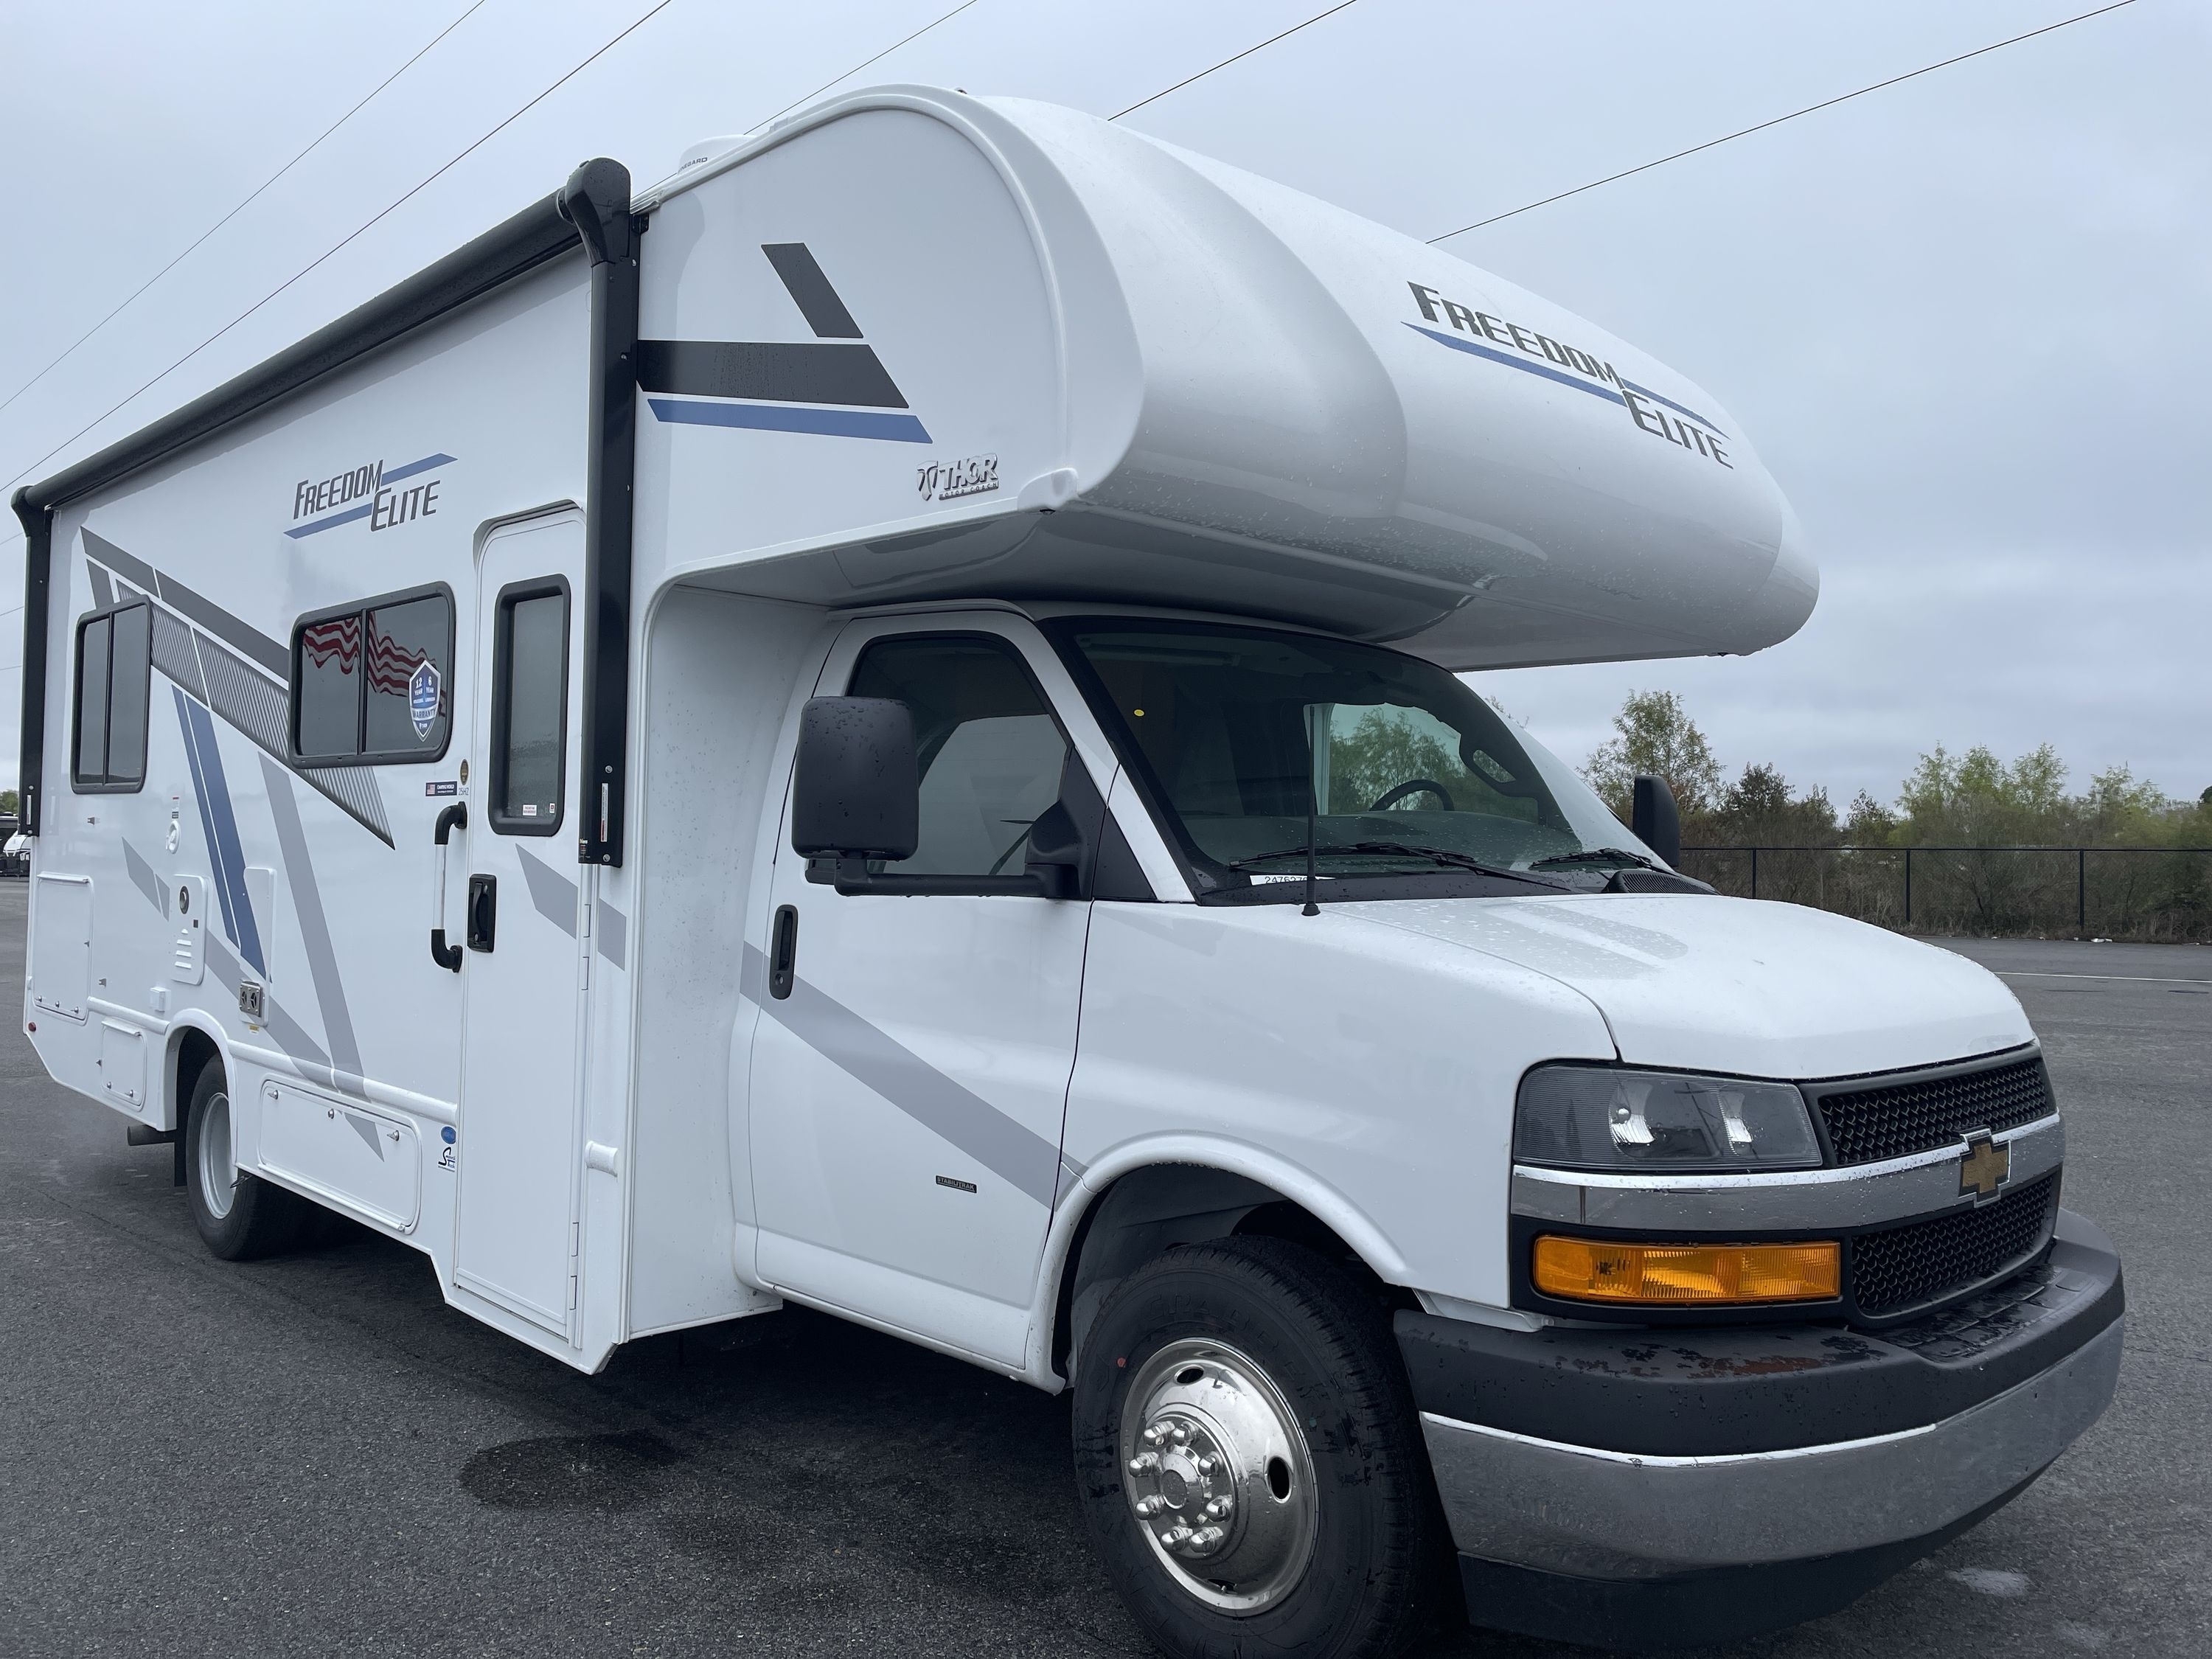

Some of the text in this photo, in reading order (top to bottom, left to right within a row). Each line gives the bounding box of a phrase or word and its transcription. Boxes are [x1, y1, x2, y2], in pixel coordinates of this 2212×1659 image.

[678, 157, 708, 173] INEGARD
[1407, 280, 1625, 389] FREEDOM
[1621, 389, 1734, 470] ELITE
[939, 453, 998, 490] THOR
[293, 459, 383, 520] FREEDOM
[939, 482, 998, 499] MOTOR COACH
[370, 480, 441, 532] ELITE
[416, 677, 422, 689] 12
[428, 676, 432, 686] 6
[414, 688, 423, 696] YEAR
[412, 708, 437, 719] WARRANTY
[937, 1176, 975, 1191] STABILITRAK
